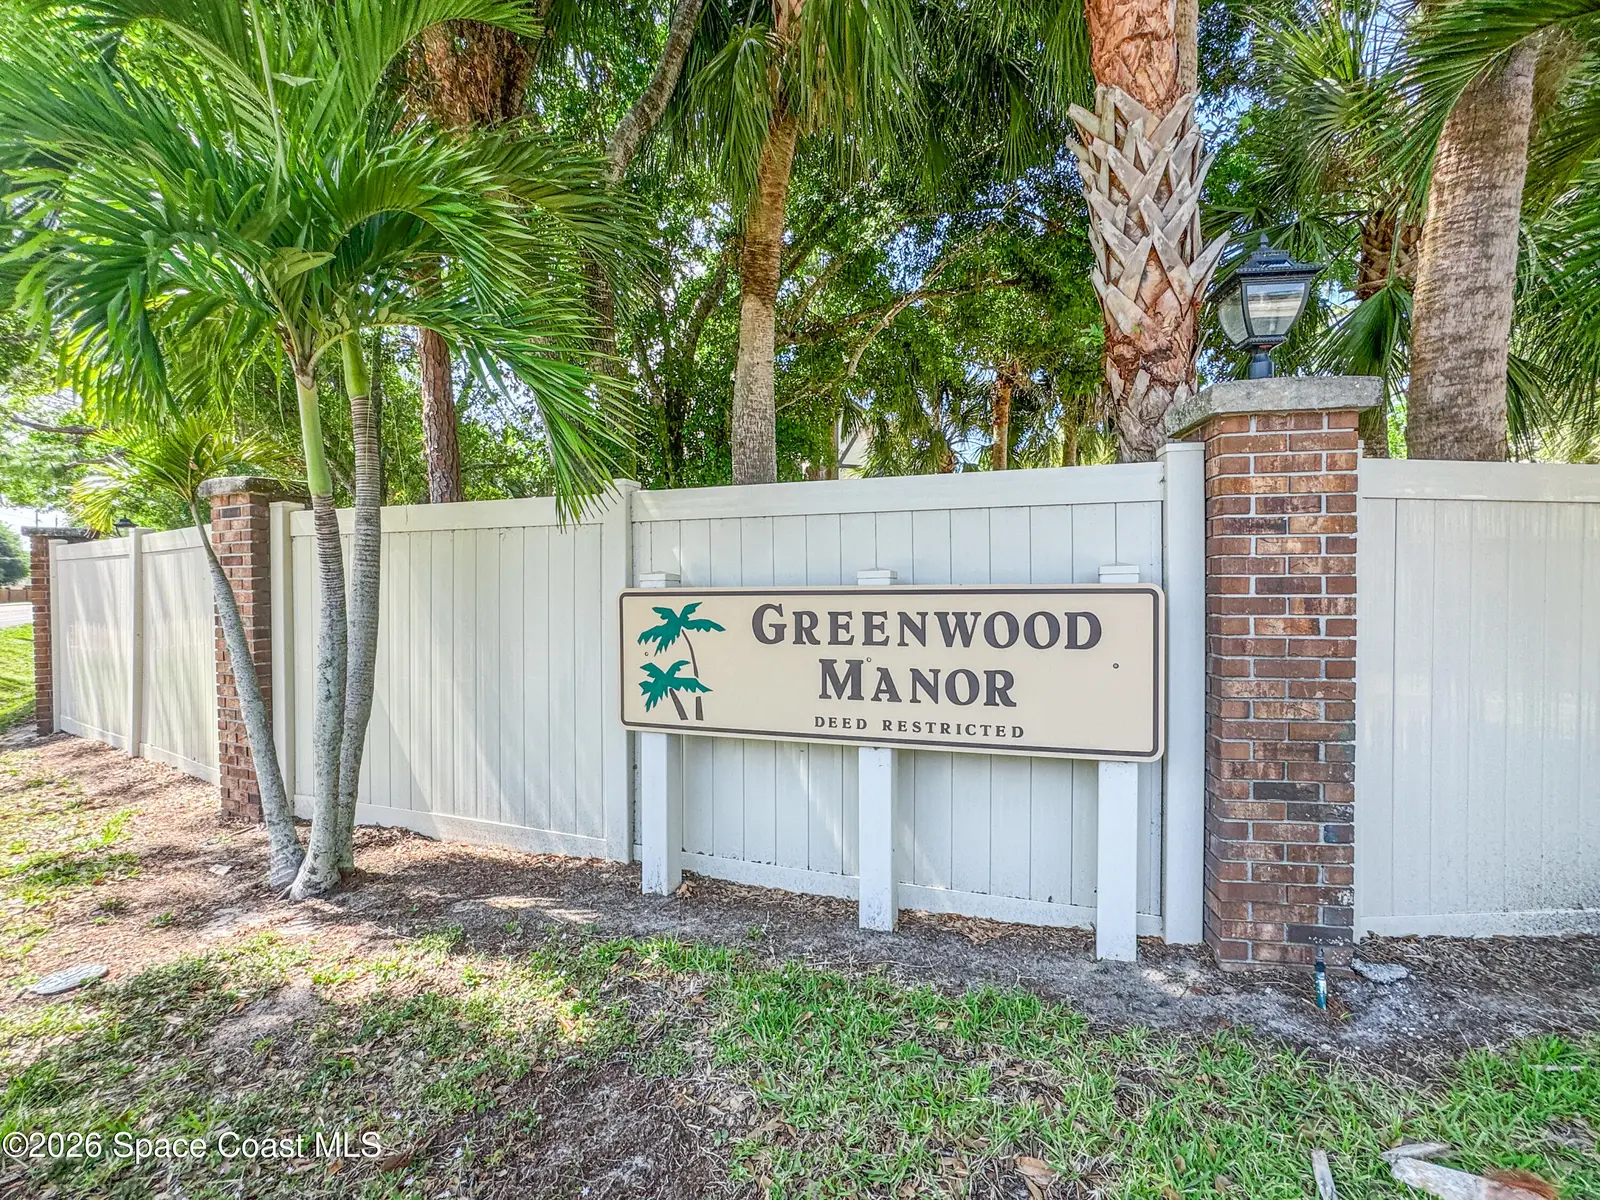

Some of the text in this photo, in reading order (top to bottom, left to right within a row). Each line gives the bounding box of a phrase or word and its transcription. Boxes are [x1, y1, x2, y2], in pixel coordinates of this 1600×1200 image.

[752, 602, 1102, 649] GREENWOOD
[818, 658, 1017, 707] MANOR
[814, 716, 1024, 738] DEED RESTRICTED
